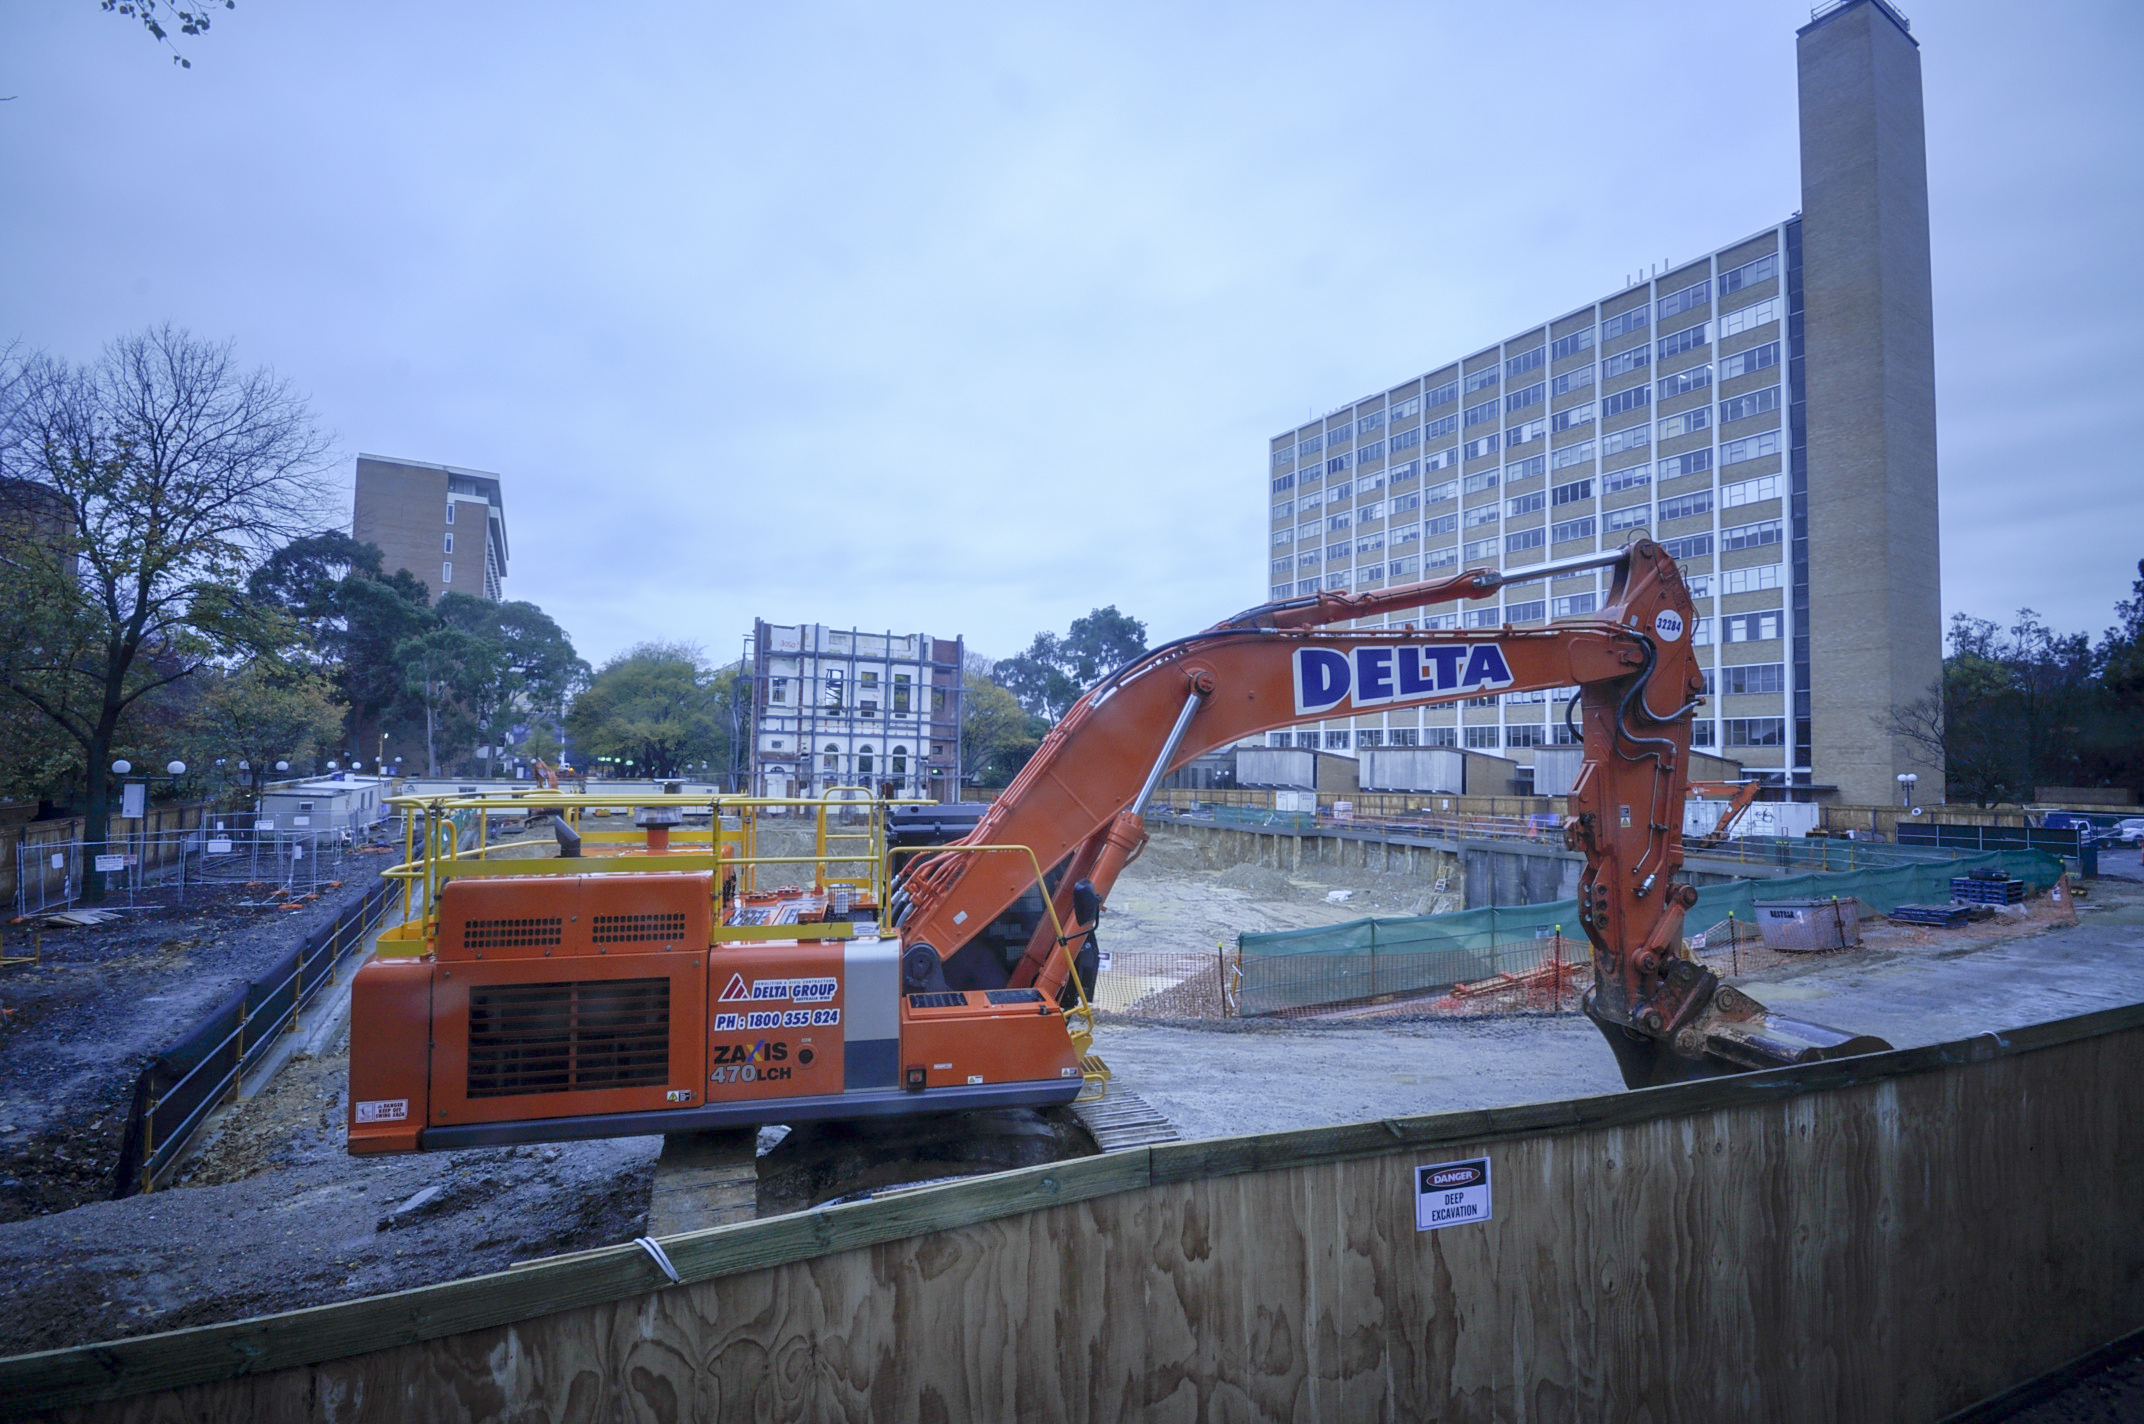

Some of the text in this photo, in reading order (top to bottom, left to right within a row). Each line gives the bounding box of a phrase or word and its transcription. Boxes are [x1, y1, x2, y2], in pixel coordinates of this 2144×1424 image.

[1657, 618, 1681, 632] 32284
[1297, 644, 1513, 711] DELTA
[753, 984, 835, 998] DELTA GROUP
[750, 1013, 780, 1027] 1800
[785, 1012, 810, 1026] 355
[814, 1011, 838, 1023] 824
[714, 1040, 788, 1064] ZAXIS
[1434, 1171, 1472, 1184] DANGER
[1445, 1192, 1464, 1205] DEEP
[1432, 1204, 1477, 1221] EXCAVATION
